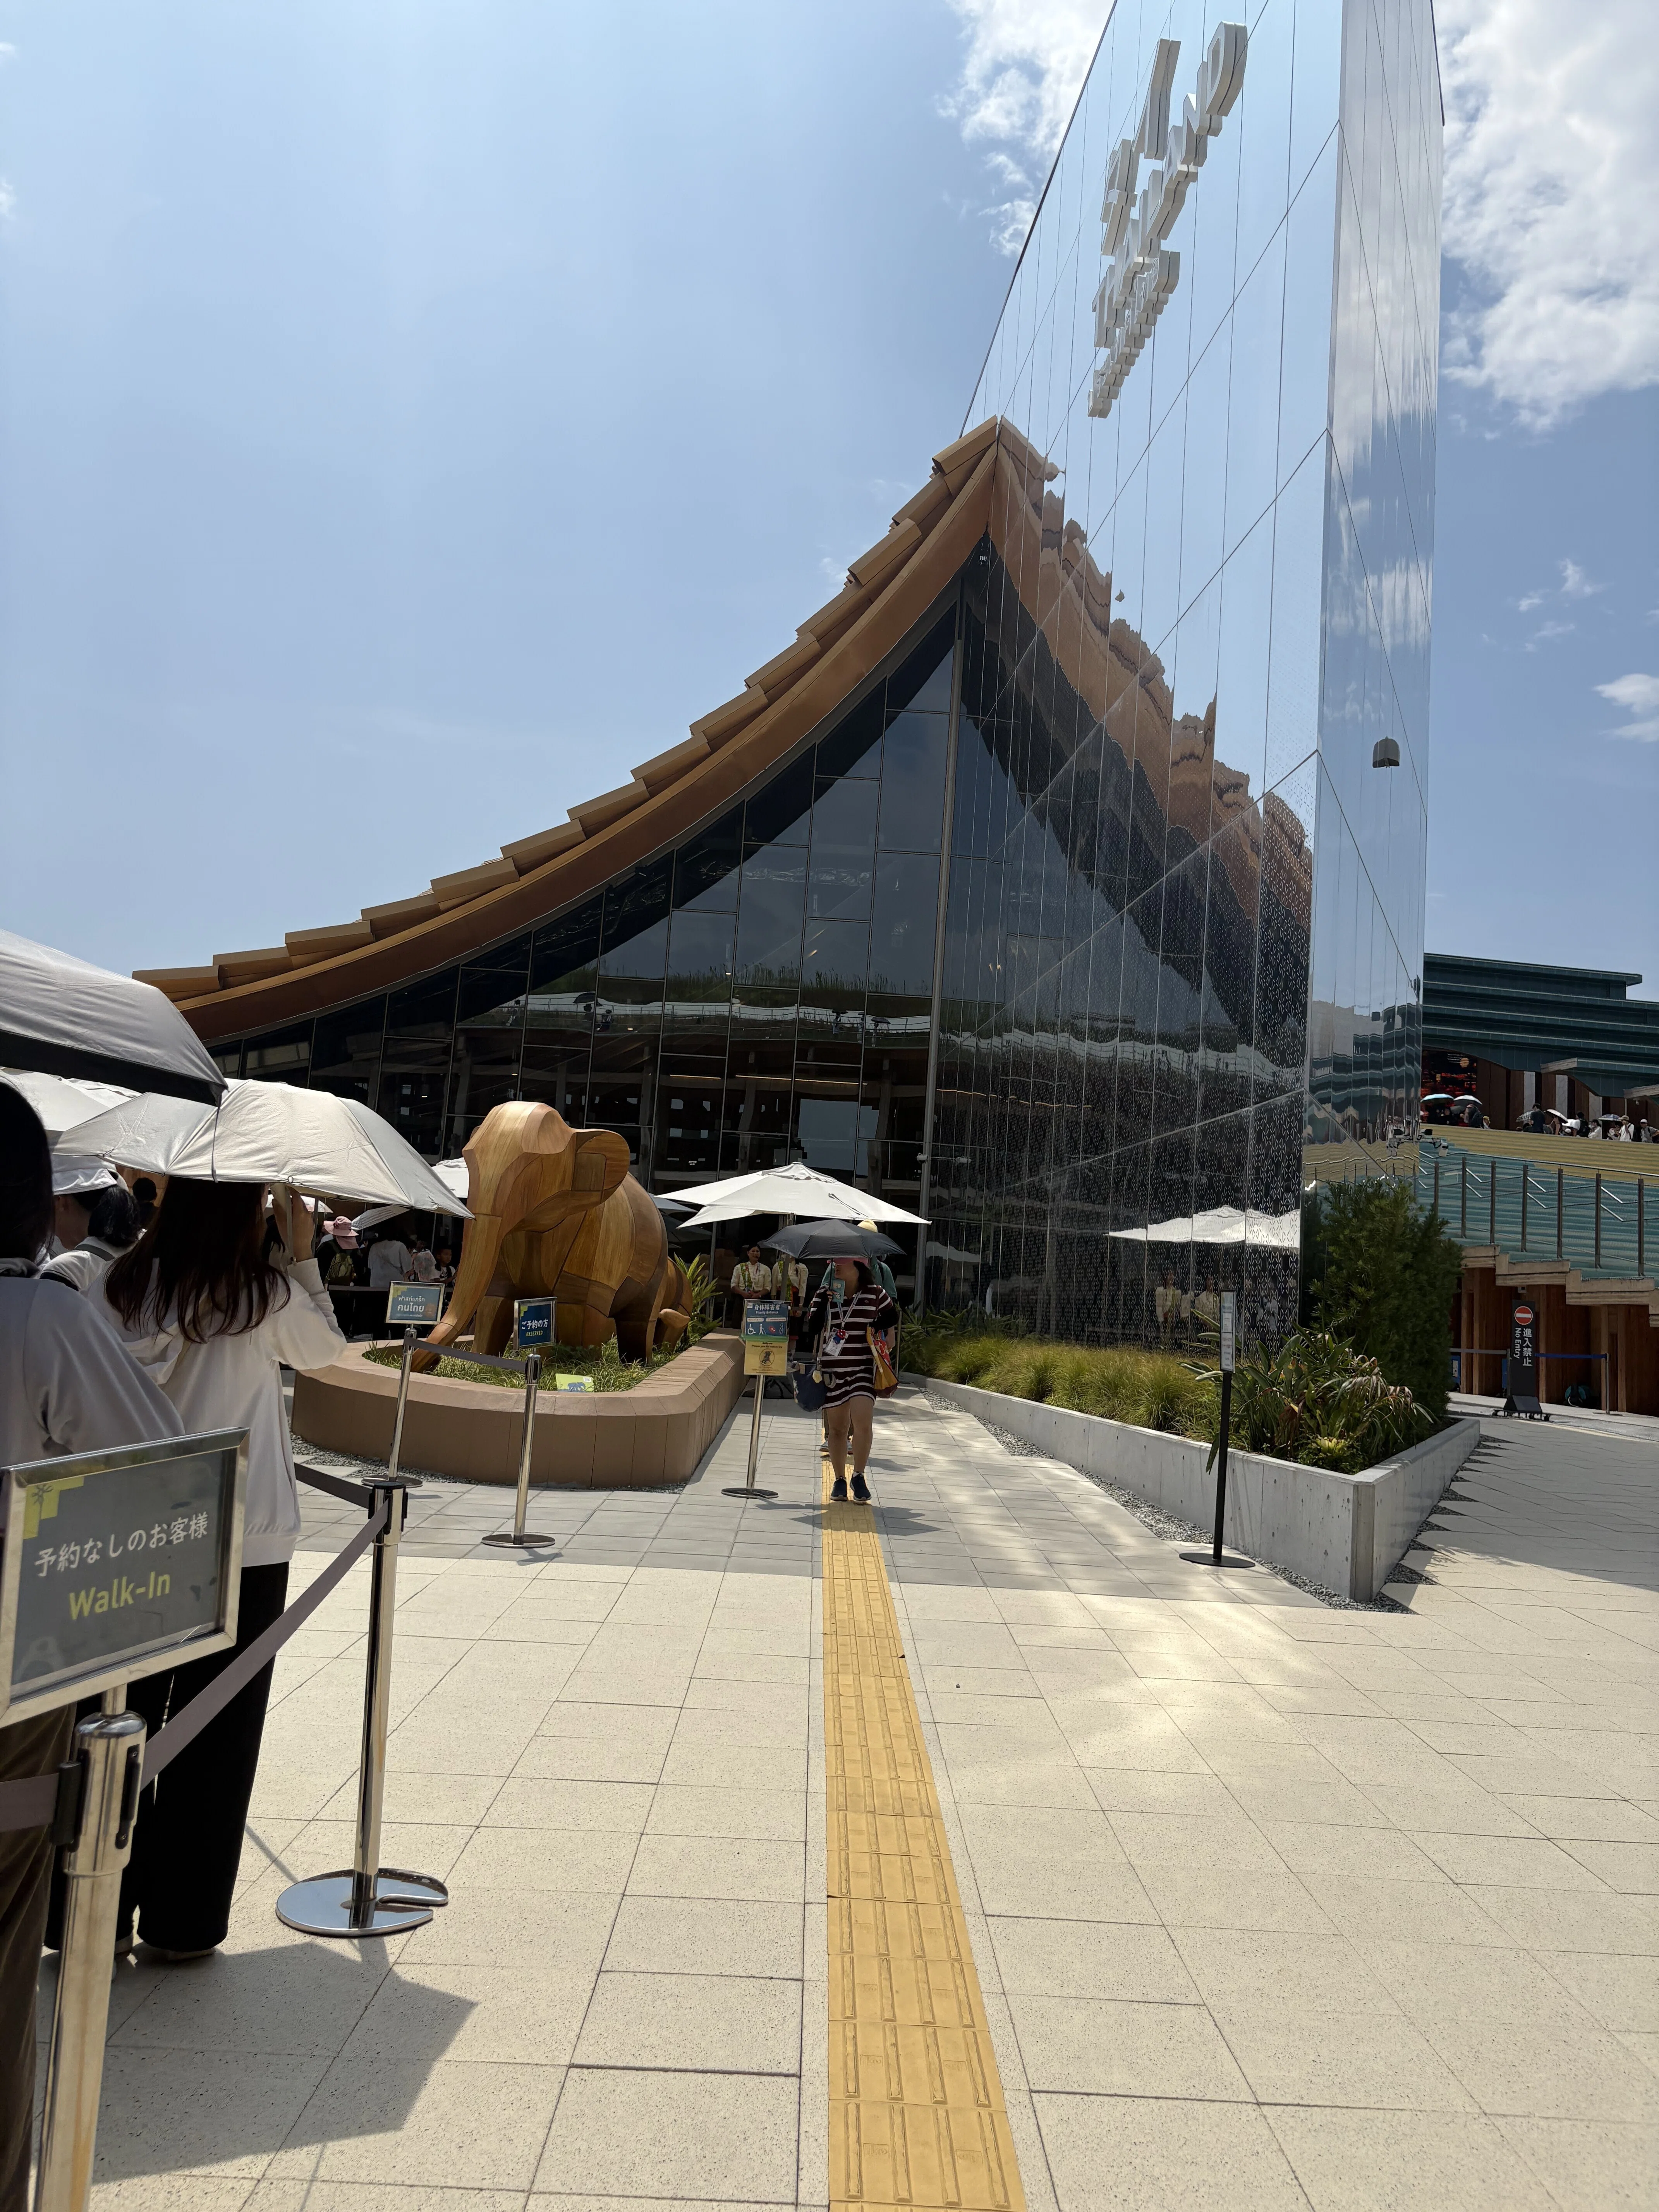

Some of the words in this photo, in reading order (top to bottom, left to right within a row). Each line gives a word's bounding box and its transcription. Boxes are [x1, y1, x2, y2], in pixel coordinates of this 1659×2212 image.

[1092, 21, 1247, 348] THAILAND
[397, 1302, 424, 1312] คนไทย
[522, 1318, 548, 1329] ご予約の方
[1515, 1328, 1521, 1338] No
[1523, 1328, 1532, 1366] 進入禁止
[34, 1511, 209, 1577] 予約なしのお客様
[69, 1571, 171, 1621] Walk-In
